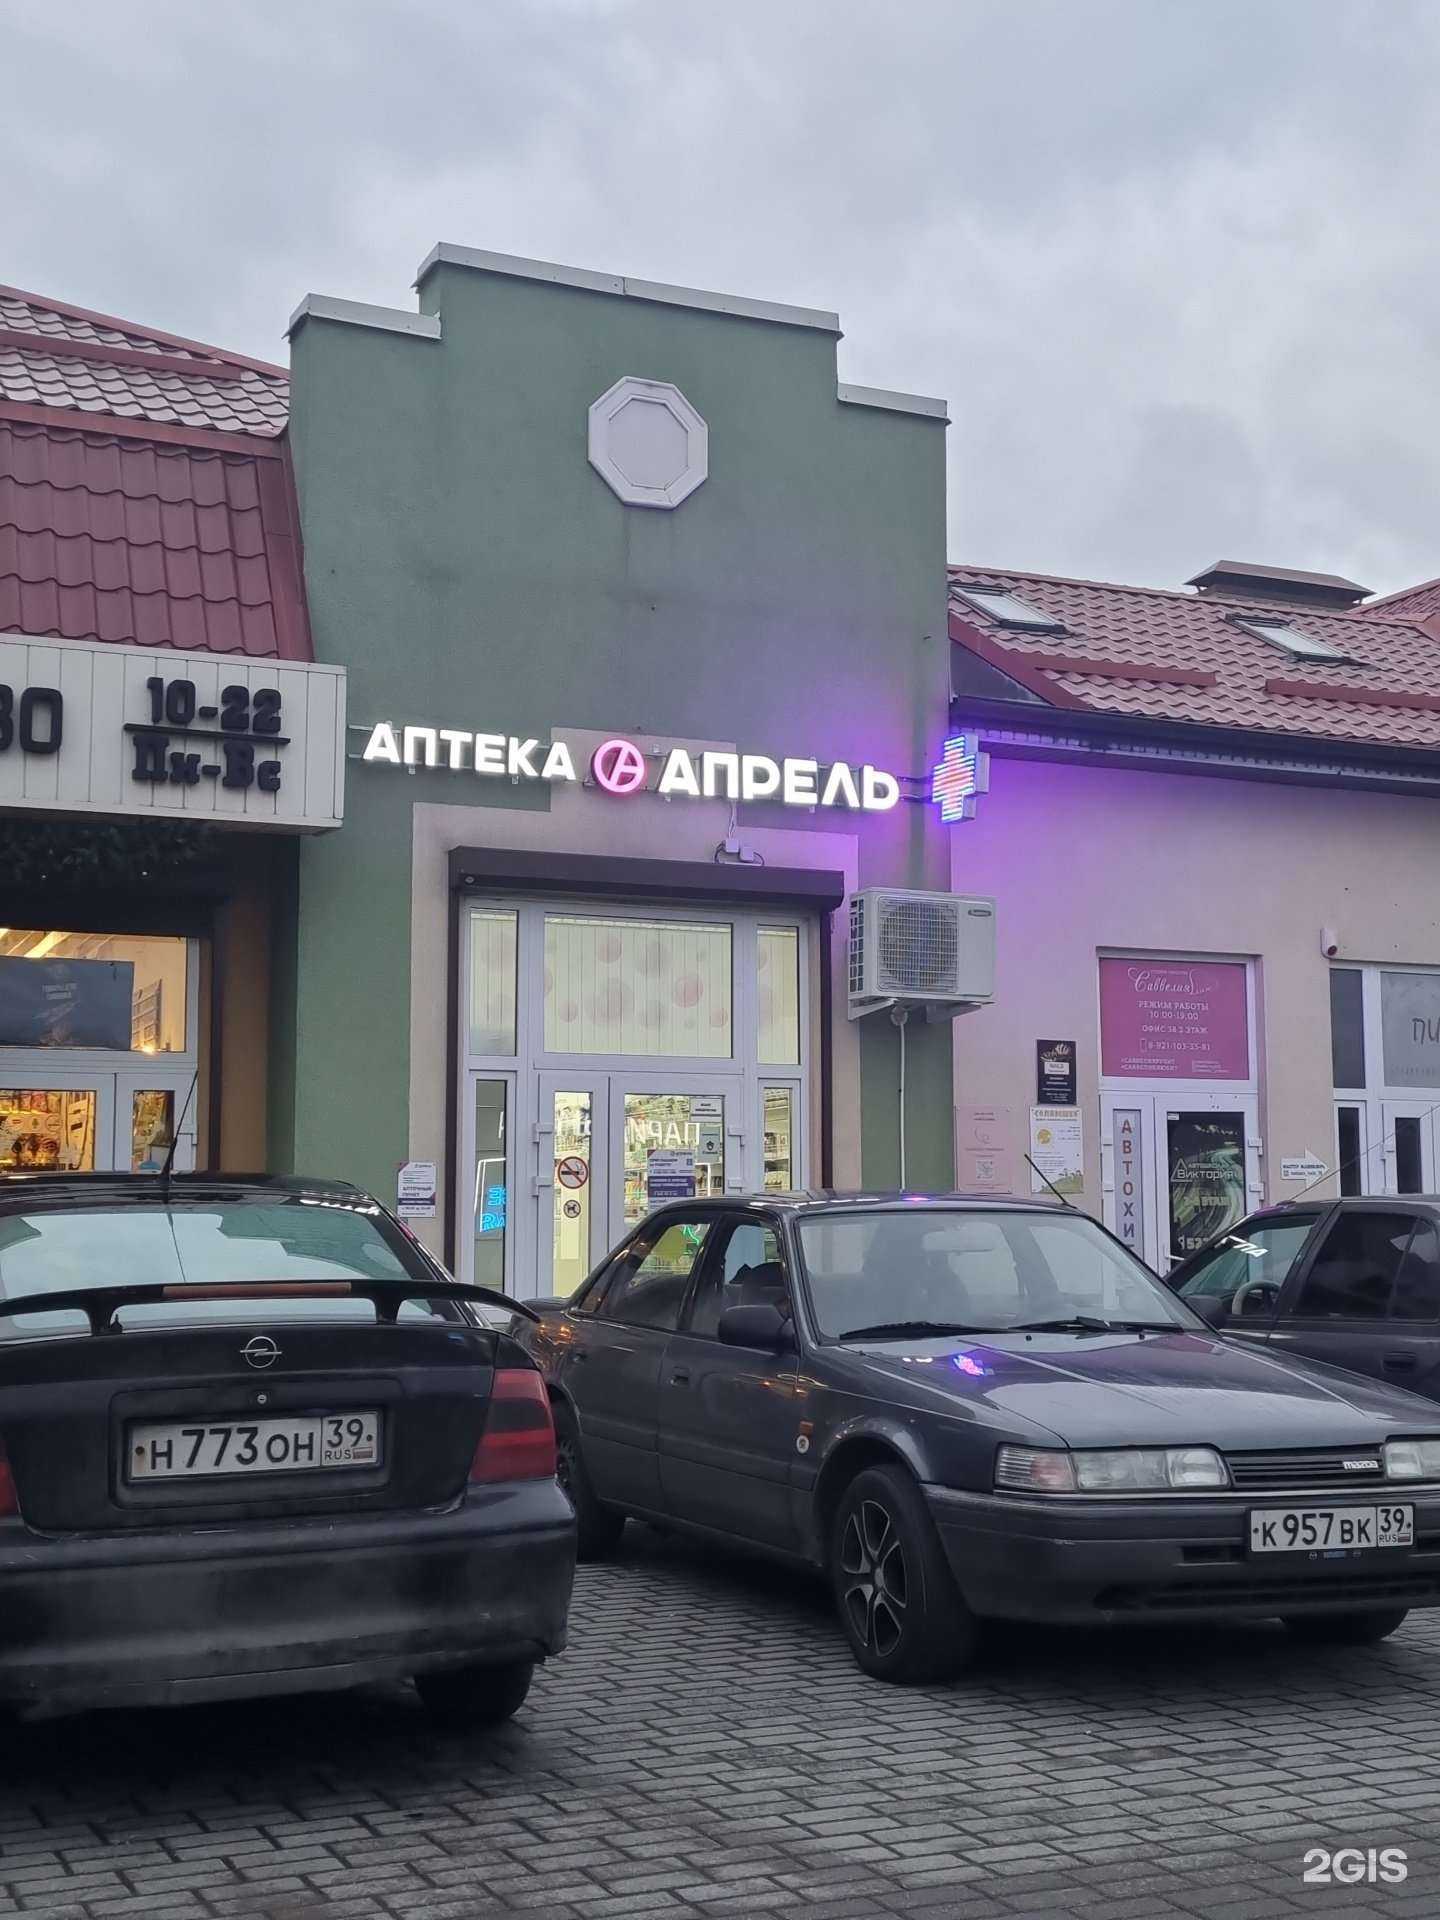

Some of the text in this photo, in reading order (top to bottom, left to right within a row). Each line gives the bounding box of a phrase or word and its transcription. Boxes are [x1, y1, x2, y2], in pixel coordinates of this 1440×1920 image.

[146, 676, 282, 734] 10-22
[362, 722, 577, 781] АПТЕКА
[658, 748, 901, 811] АПРЕЛЬ
[1138, 1000, 1209, 1011] РЕЖИМ РАБОТЫ
[1142, 1024, 1165, 1034] ОФИС
[1186, 1026, 1209, 1035] ЭТАЖ
[1121, 1119, 1136, 1248] АВТОХИ
[1177, 1168, 1234, 1181] Виктория
[150, 1418, 364, 1470] Н773ОН 39
[324, 1449, 351, 1461] RUS
[1262, 1508, 1405, 1547] К957ВК 39
[1378, 1534, 1397, 1543] RUS
